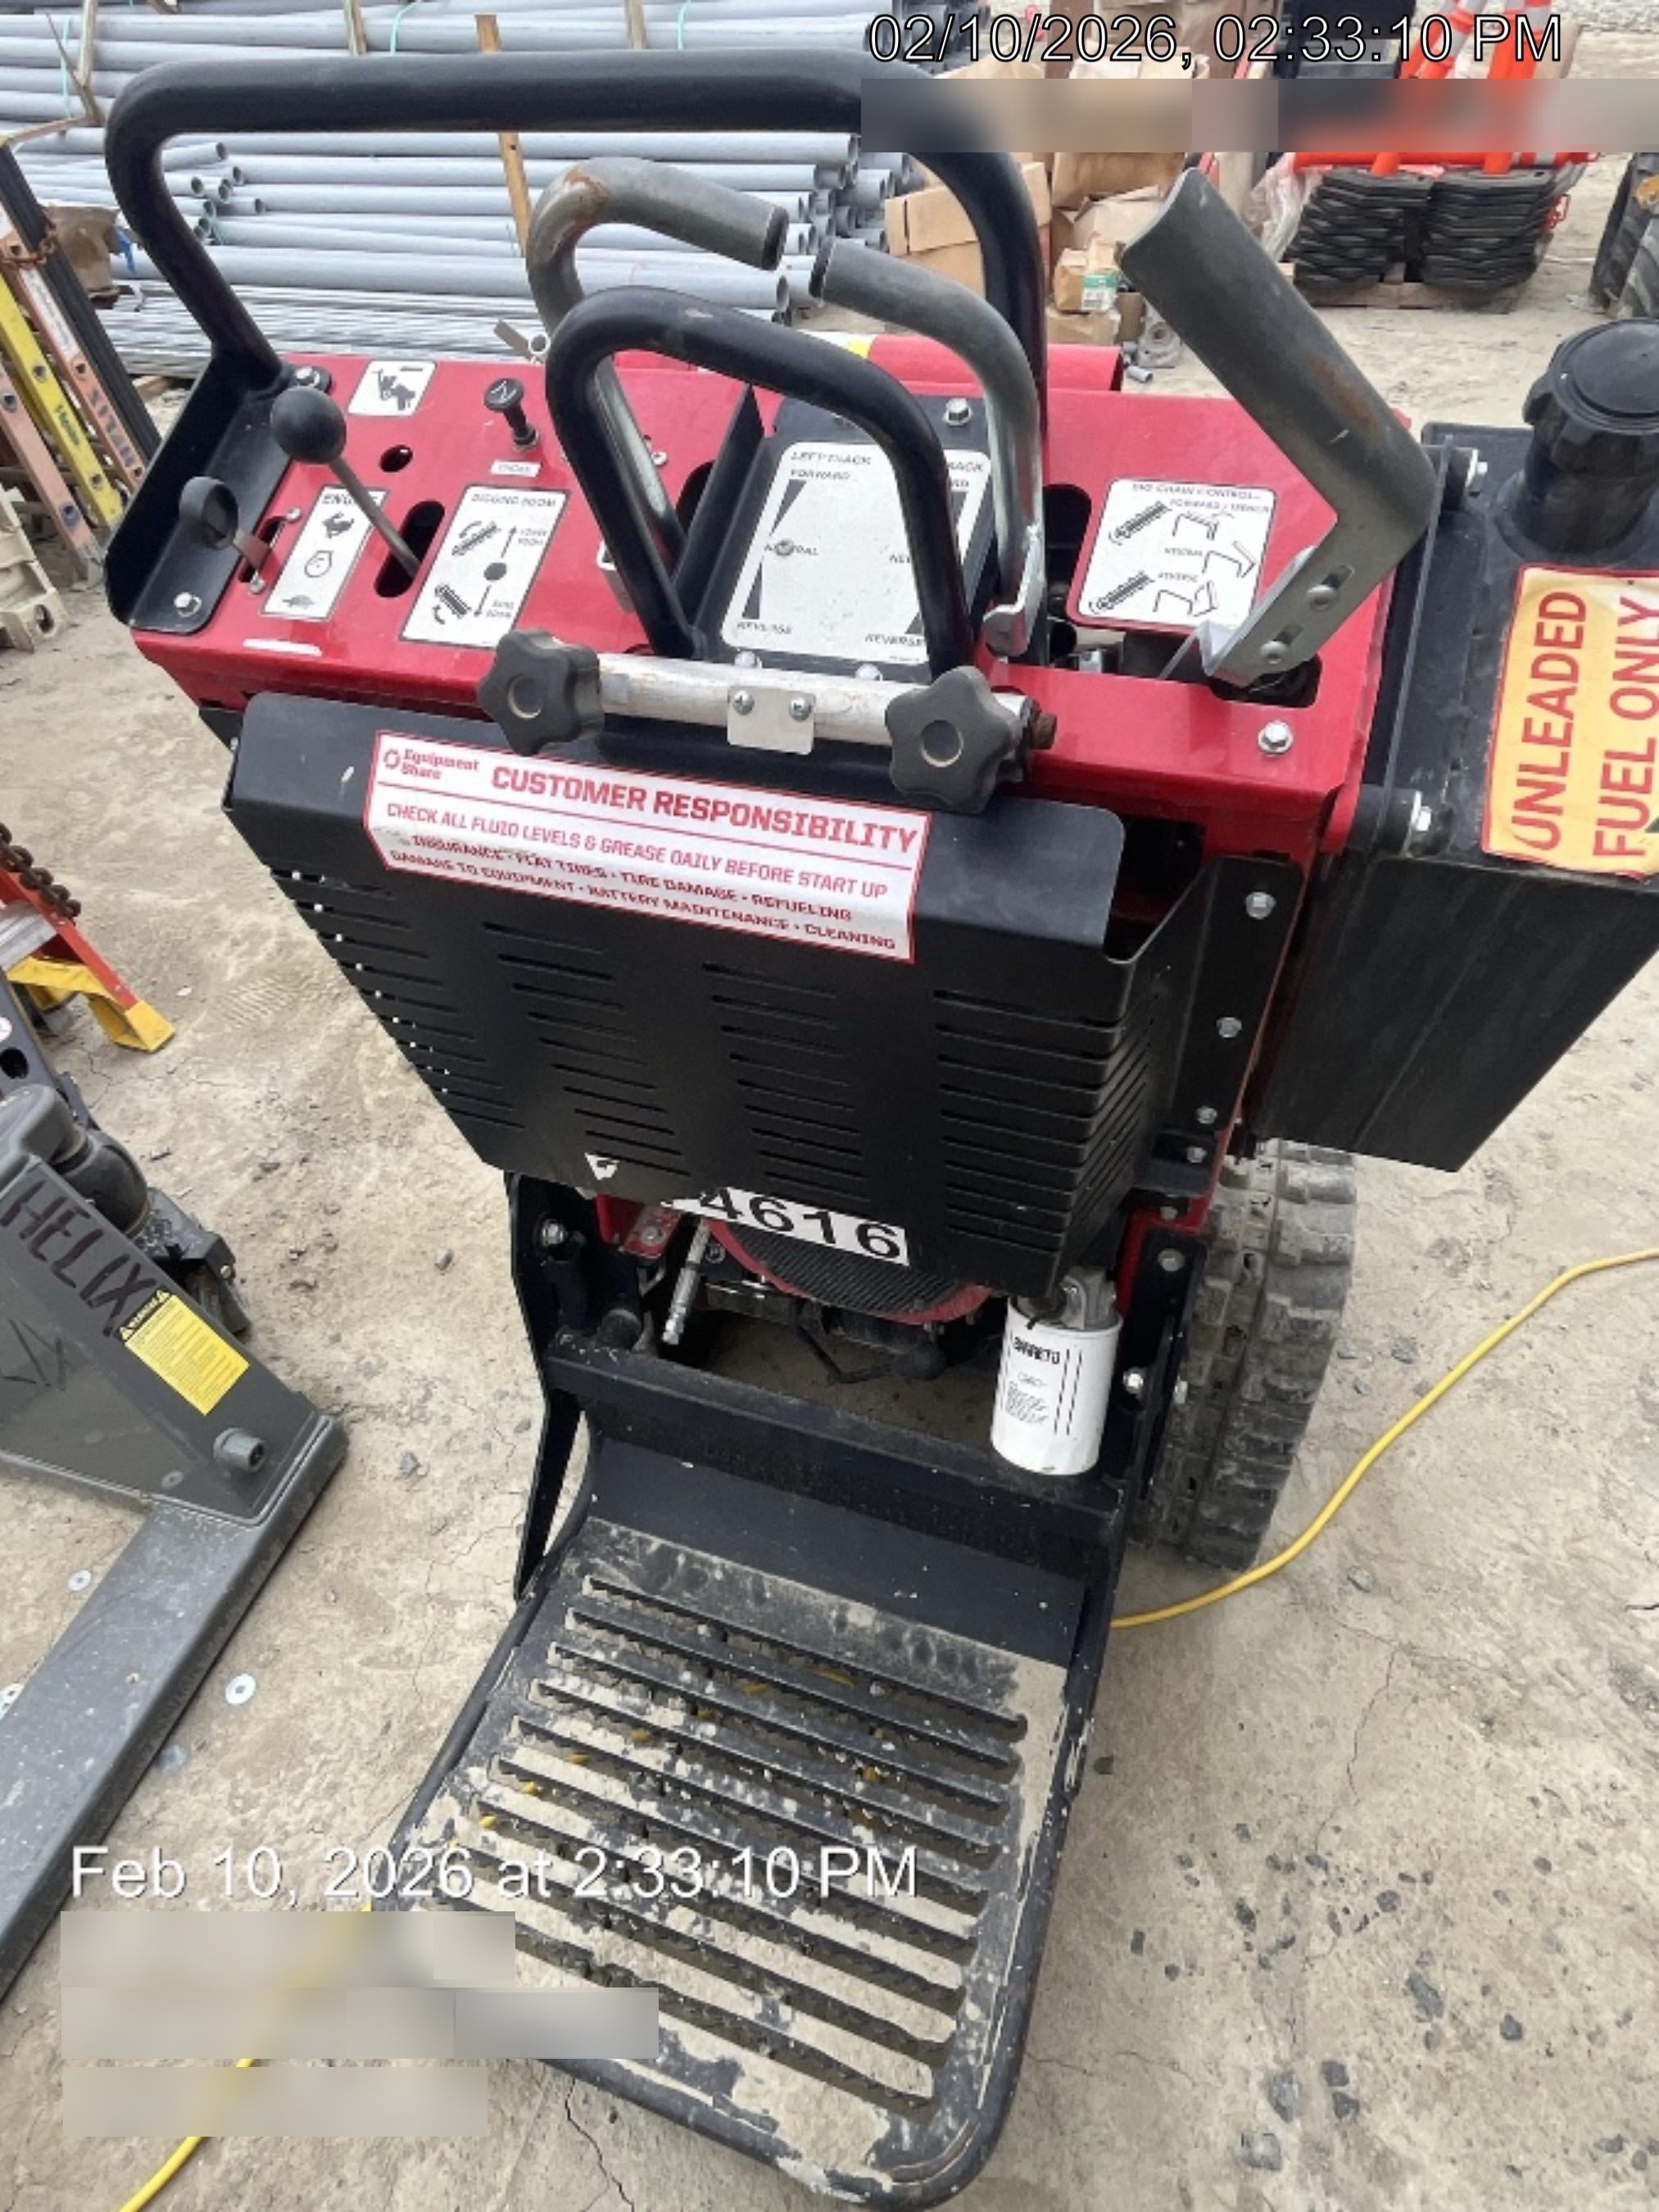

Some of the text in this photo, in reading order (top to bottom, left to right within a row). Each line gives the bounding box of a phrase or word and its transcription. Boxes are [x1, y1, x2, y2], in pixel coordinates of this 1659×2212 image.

[403, 749, 480, 771] Equipment
[1512, 592, 1586, 851] UNLEADED
[1593, 596, 1659, 856] FUEL ONLY
[401, 762, 442, 780] Share
[492, 766, 918, 853] CUSTOMER RESPONSIBILITY
[388, 803, 887, 899] CHECK ALL FLUID LEVELS & GREASE DAILY BEFORE START UP
[481, 867, 576, 892] EQUIPMENT
[587, 883, 658, 908] BATTERY
[663, 898, 790, 930] MAINTENANCE
[805, 922, 895, 950] CLEANING
[621, 870, 660, 889] TIRE
[663, 878, 737, 901] DAMAGE
[752, 893, 851, 922] REFUELING
[0, 1180, 158, 1337] HELIX
[699, 1186, 901, 1259] 4616
